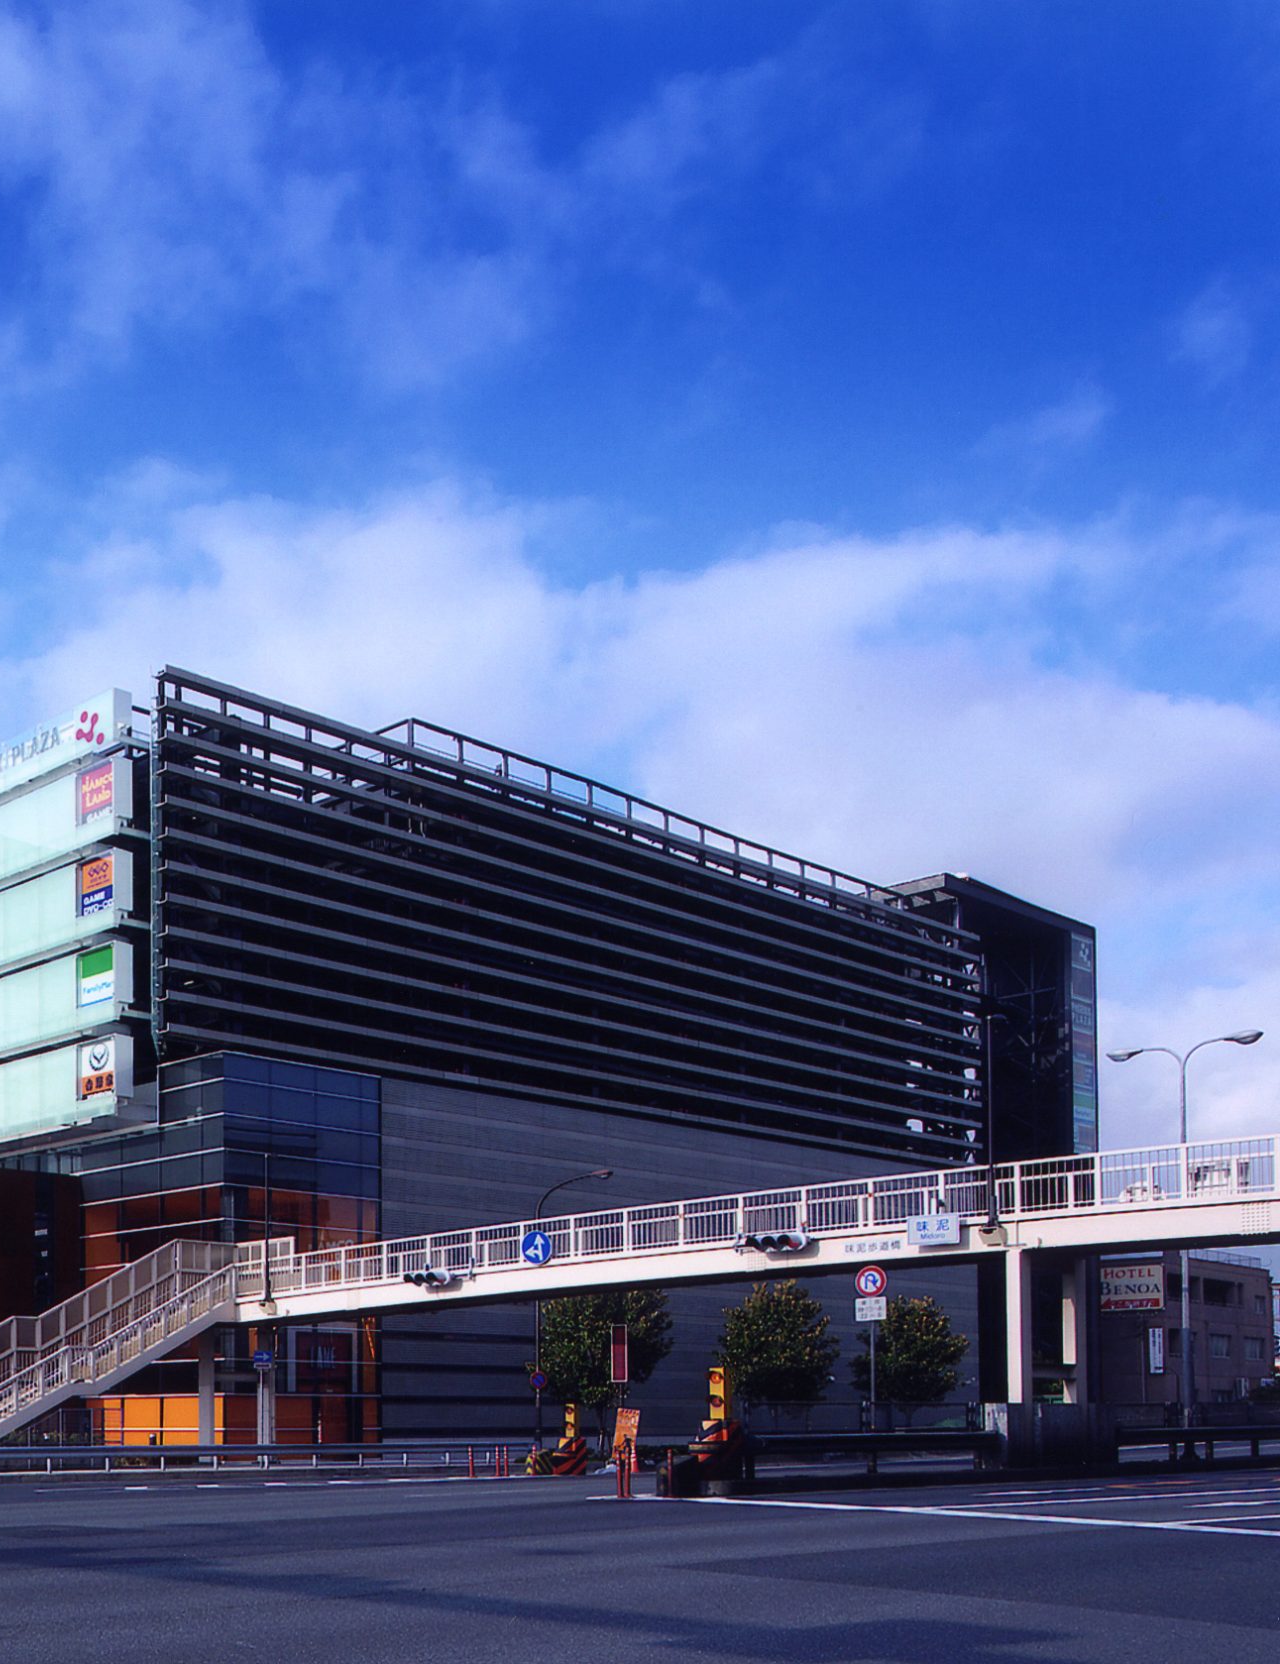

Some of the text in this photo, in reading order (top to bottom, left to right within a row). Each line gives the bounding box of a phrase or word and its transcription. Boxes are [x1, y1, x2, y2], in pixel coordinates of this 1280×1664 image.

[11, 726, 61, 768] PLAZA
[1104, 1268, 1154, 1280] HOTEL
[1100, 1281, 1161, 1296] BENOA
